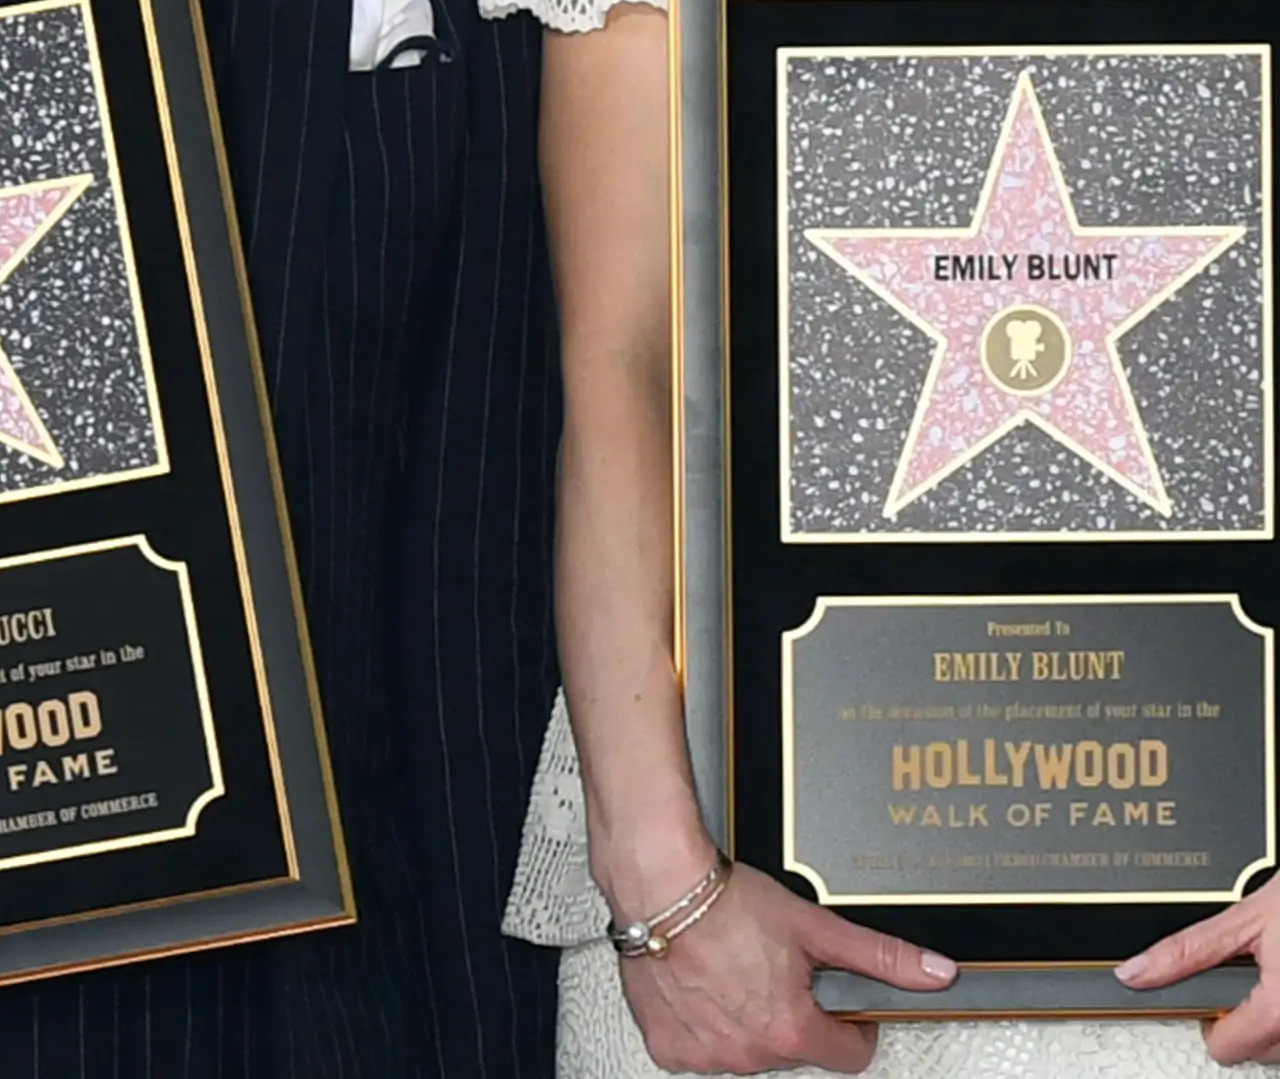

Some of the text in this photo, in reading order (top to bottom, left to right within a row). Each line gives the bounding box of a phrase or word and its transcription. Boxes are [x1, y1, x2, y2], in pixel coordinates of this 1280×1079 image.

[933, 253, 1118, 282] EMILY BLUNT
[987, 621, 1051, 637] Presented
[9, 663, 26, 682] of
[27, 660, 63, 682] your
[65, 652, 97, 671] star
[100, 648, 118, 666] in
[119, 644, 146, 663] the
[933, 650, 1125, 682] EMILY BLUNT
[1005, 702, 1082, 722] placement
[1086, 701, 1101, 718] of
[1103, 703, 1138, 722] your
[1141, 703, 1173, 718] star
[1177, 700, 1192, 717] in
[1196, 700, 1221, 718] the
[7, 747, 119, 792] FAME
[891, 738, 1168, 791] HOLLYWOOD
[59, 806, 78, 823] OF
[80, 792, 159, 819] COMMERCE
[887, 801, 1177, 828] WALK OF FAME
